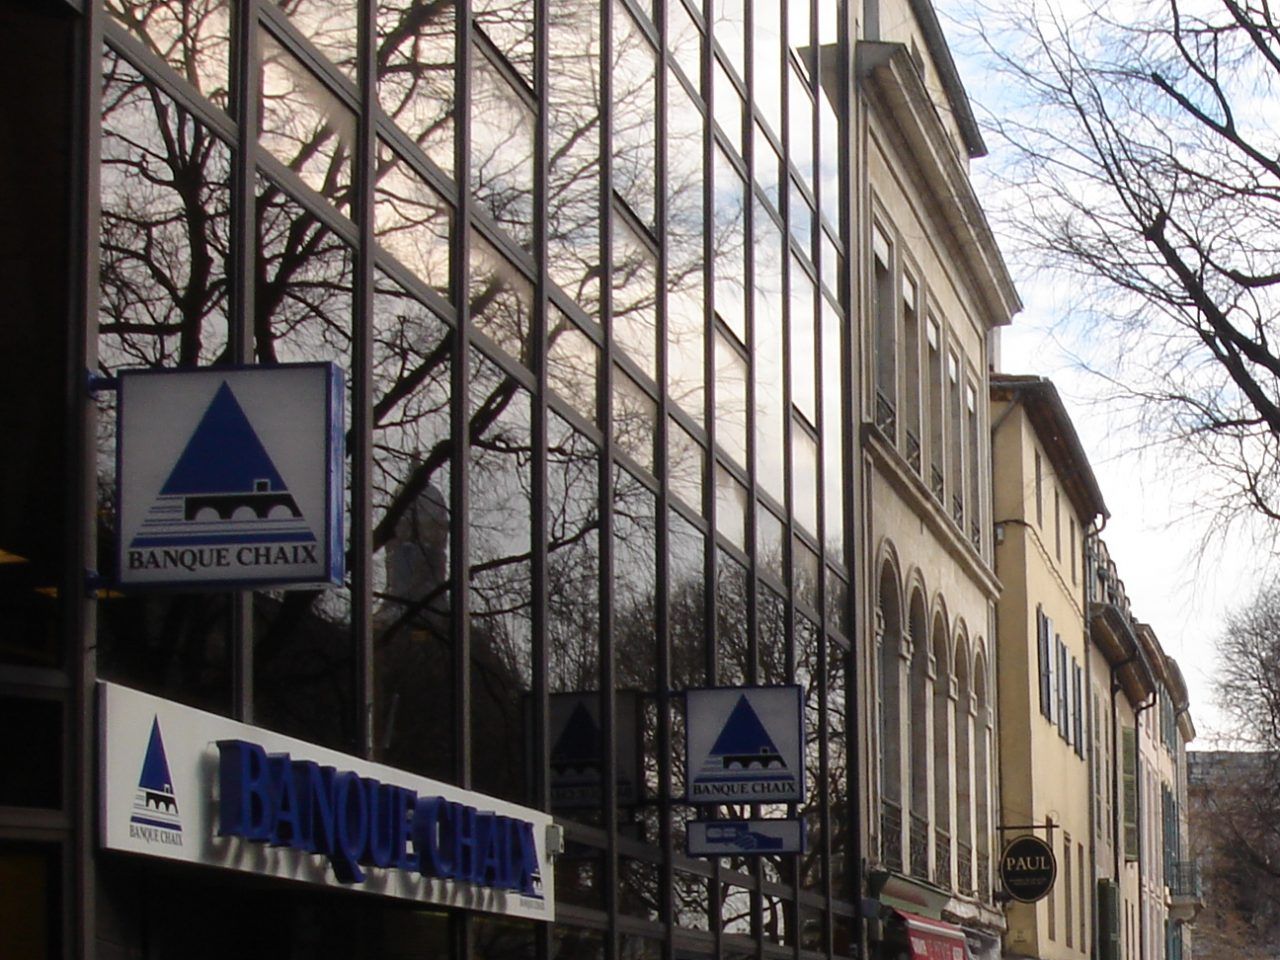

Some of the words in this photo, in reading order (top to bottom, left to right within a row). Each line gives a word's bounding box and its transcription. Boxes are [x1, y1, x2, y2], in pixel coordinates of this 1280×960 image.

[127, 548, 231, 571] BANQUE
[236, 544, 318, 566] CHAIX
[693, 784, 749, 796] BANQUE
[752, 782, 796, 793] CHAIX
[217, 739, 421, 884] BANQUE
[414, 795, 537, 897] CHAIX
[129, 824, 160, 844] BANQUE
[1006, 856, 1051, 871] PAUL
